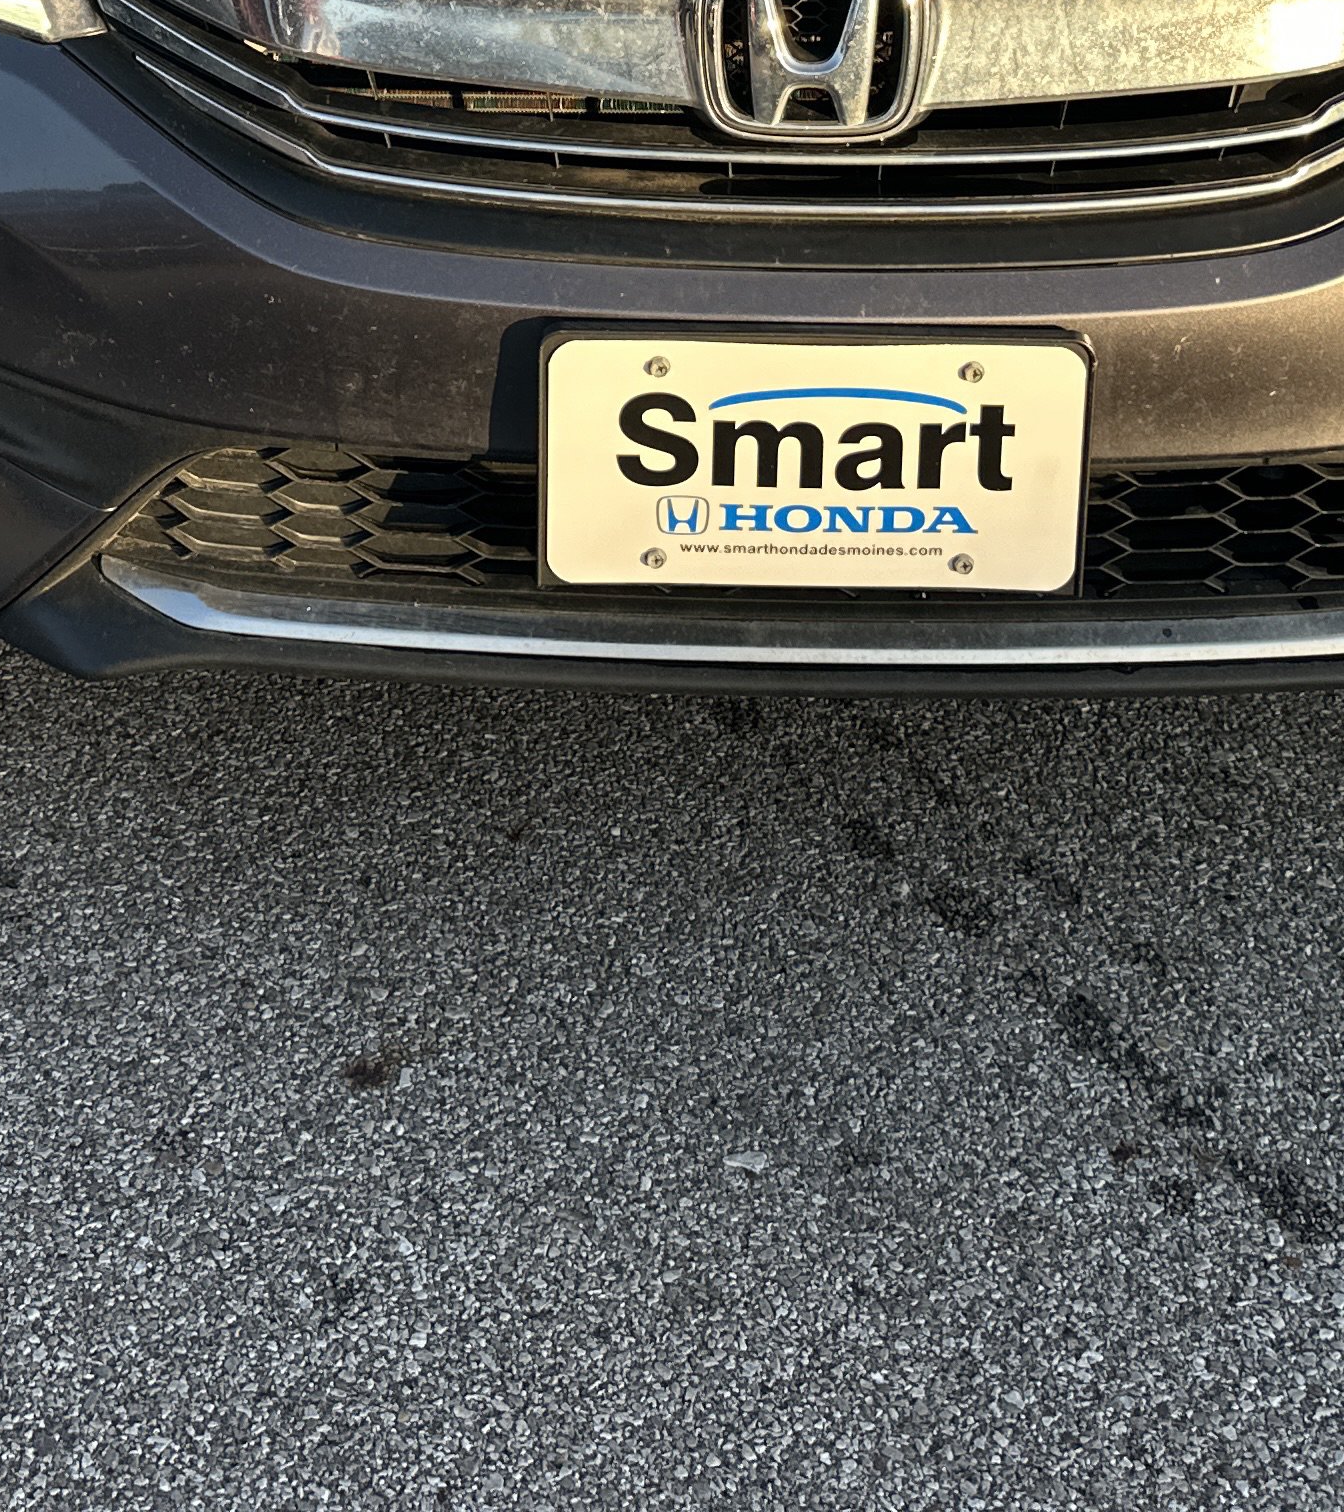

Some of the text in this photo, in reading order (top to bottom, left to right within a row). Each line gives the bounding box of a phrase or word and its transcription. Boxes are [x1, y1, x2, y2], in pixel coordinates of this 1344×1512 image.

[616, 392, 1016, 491] Smart
[718, 503, 978, 534] HONDA
[679, 543, 944, 556] www.smarthondadesmoines.com
